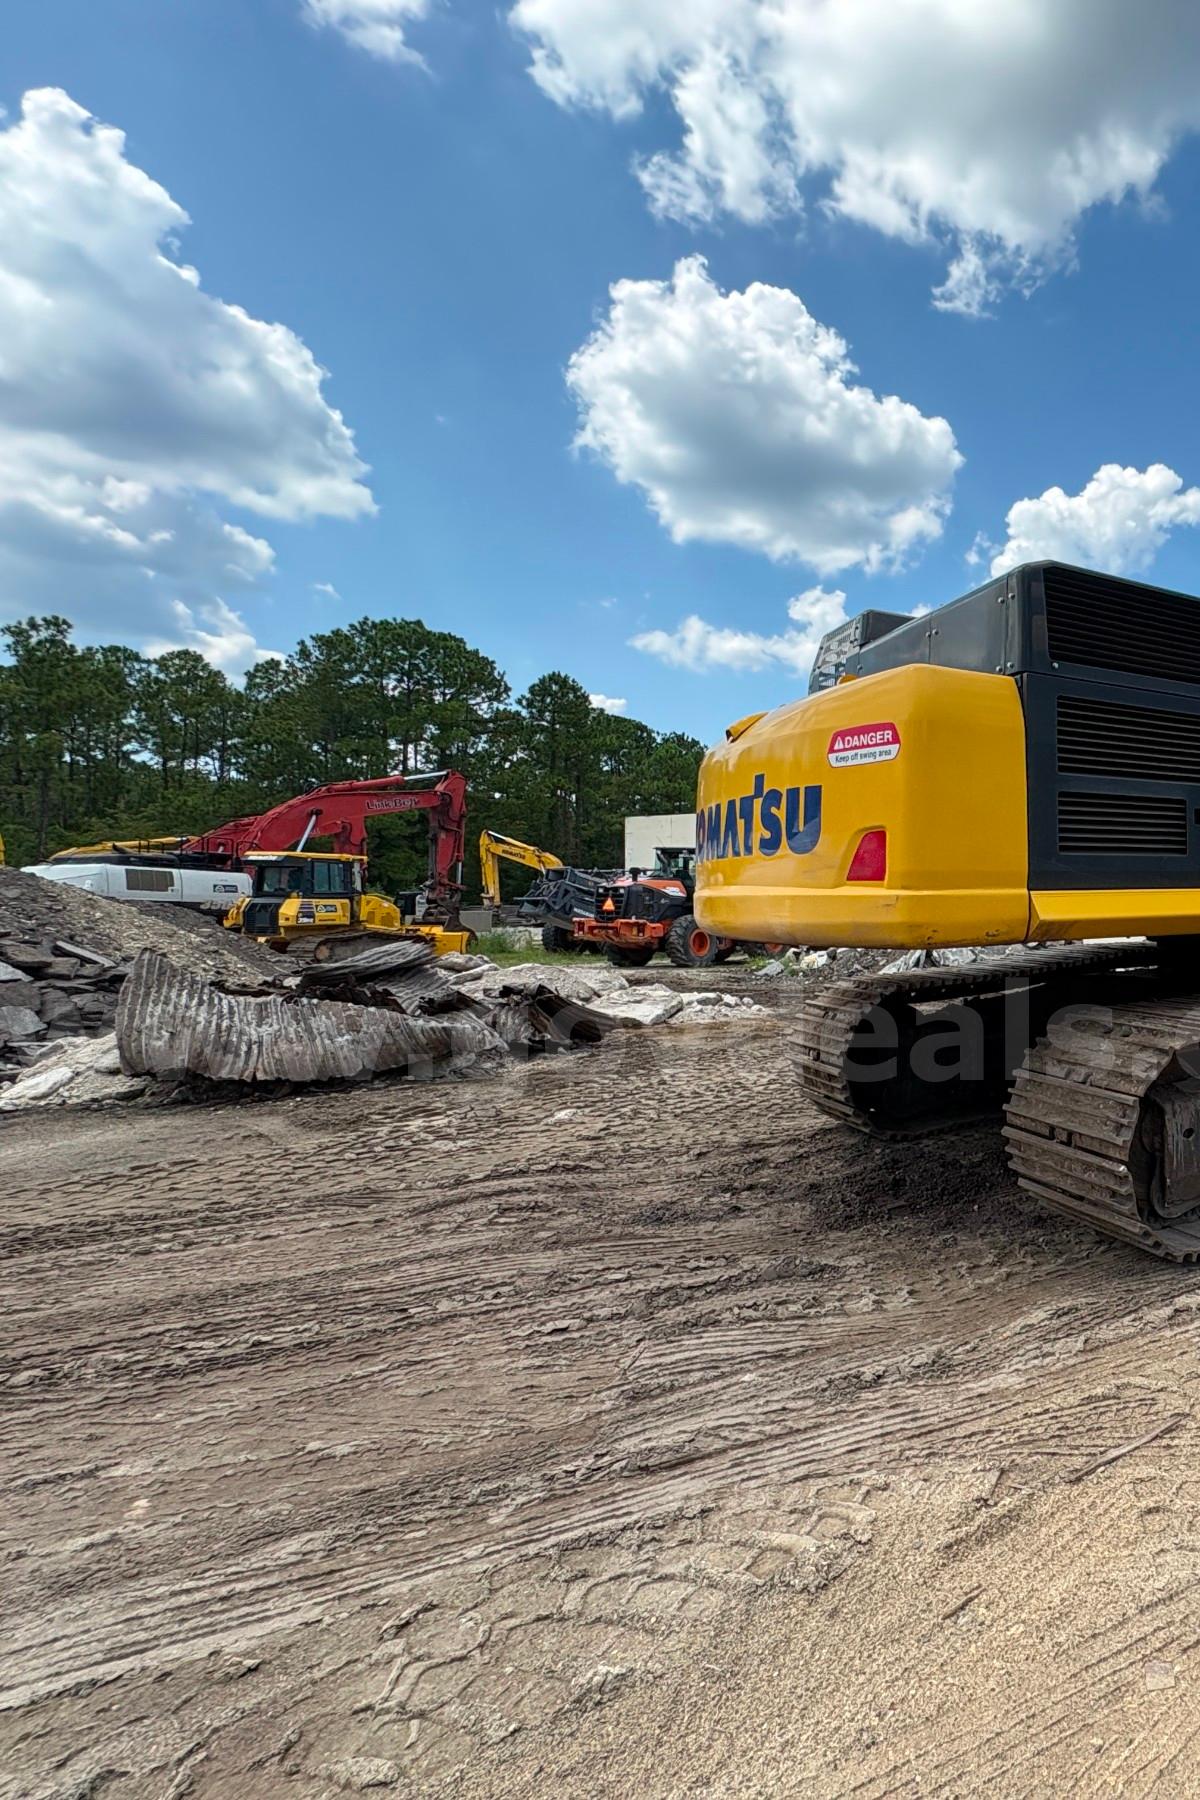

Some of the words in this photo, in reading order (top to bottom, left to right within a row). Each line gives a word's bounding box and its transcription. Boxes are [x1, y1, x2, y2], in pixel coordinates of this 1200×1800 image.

[844, 730, 893, 748] DANGER
[835, 755, 850, 764] Keep
[851, 752, 859, 761] off
[860, 750, 877, 760] swing
[878, 749, 892, 757] area
